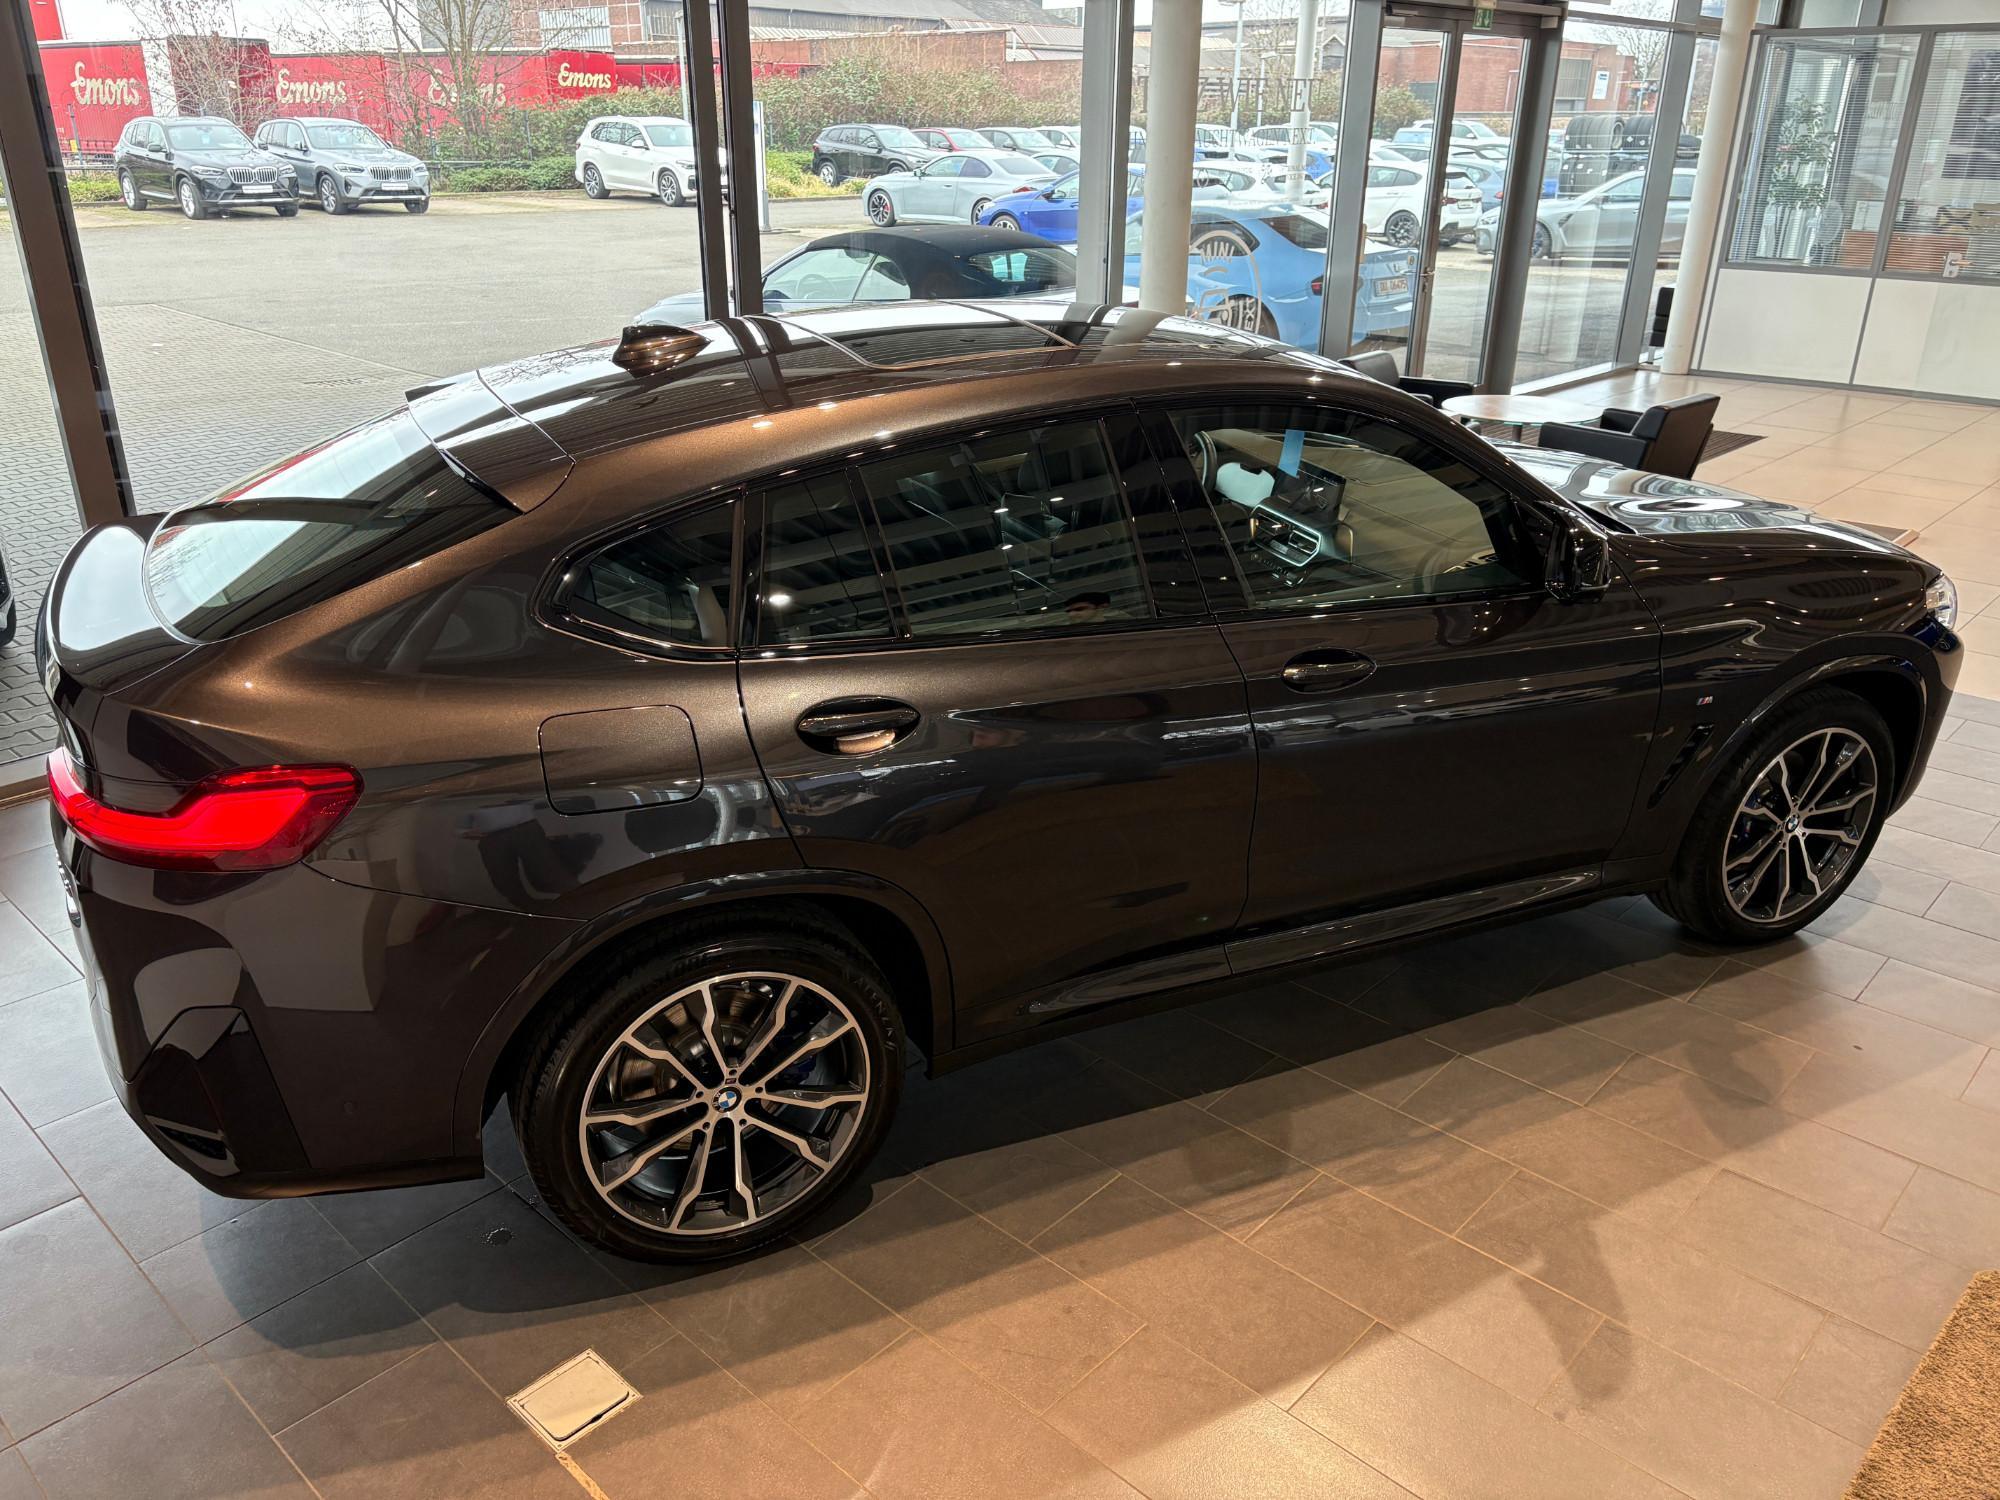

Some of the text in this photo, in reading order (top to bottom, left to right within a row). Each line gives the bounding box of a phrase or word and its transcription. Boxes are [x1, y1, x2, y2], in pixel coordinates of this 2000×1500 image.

[70, 60, 141, 106] Emons
[276, 68, 348, 105] Emons
[558, 62, 612, 89] Emons
[1200, 240, 1235, 265] MINI
[1244, 297, 1256, 331] EXT
